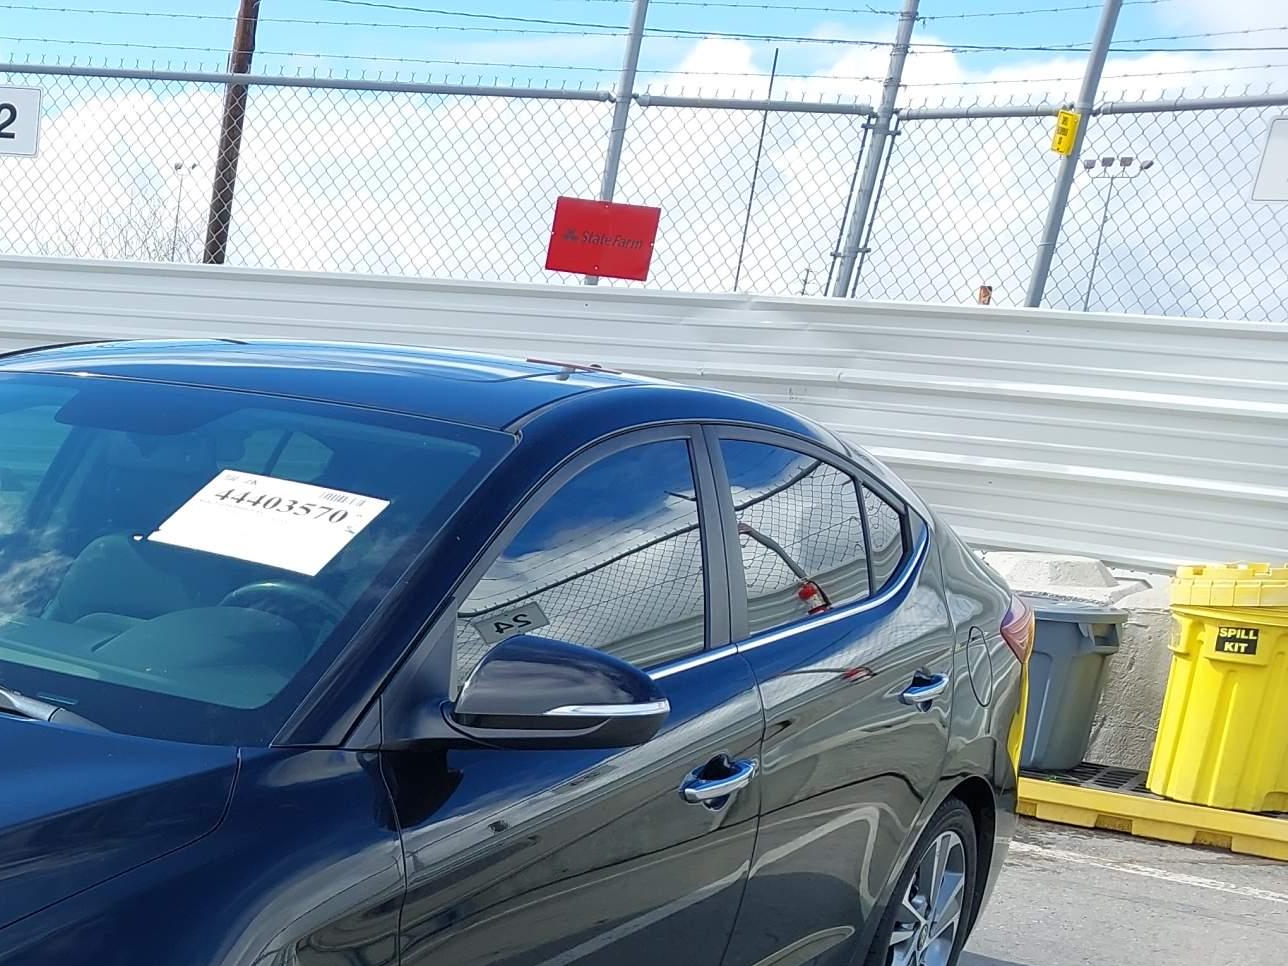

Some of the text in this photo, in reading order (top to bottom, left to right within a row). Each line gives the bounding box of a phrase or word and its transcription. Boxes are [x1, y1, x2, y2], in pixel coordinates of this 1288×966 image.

[215, 488, 349, 523] 44403570
[1219, 627, 1258, 640] SPILL
[1223, 641, 1249, 653] KIT
